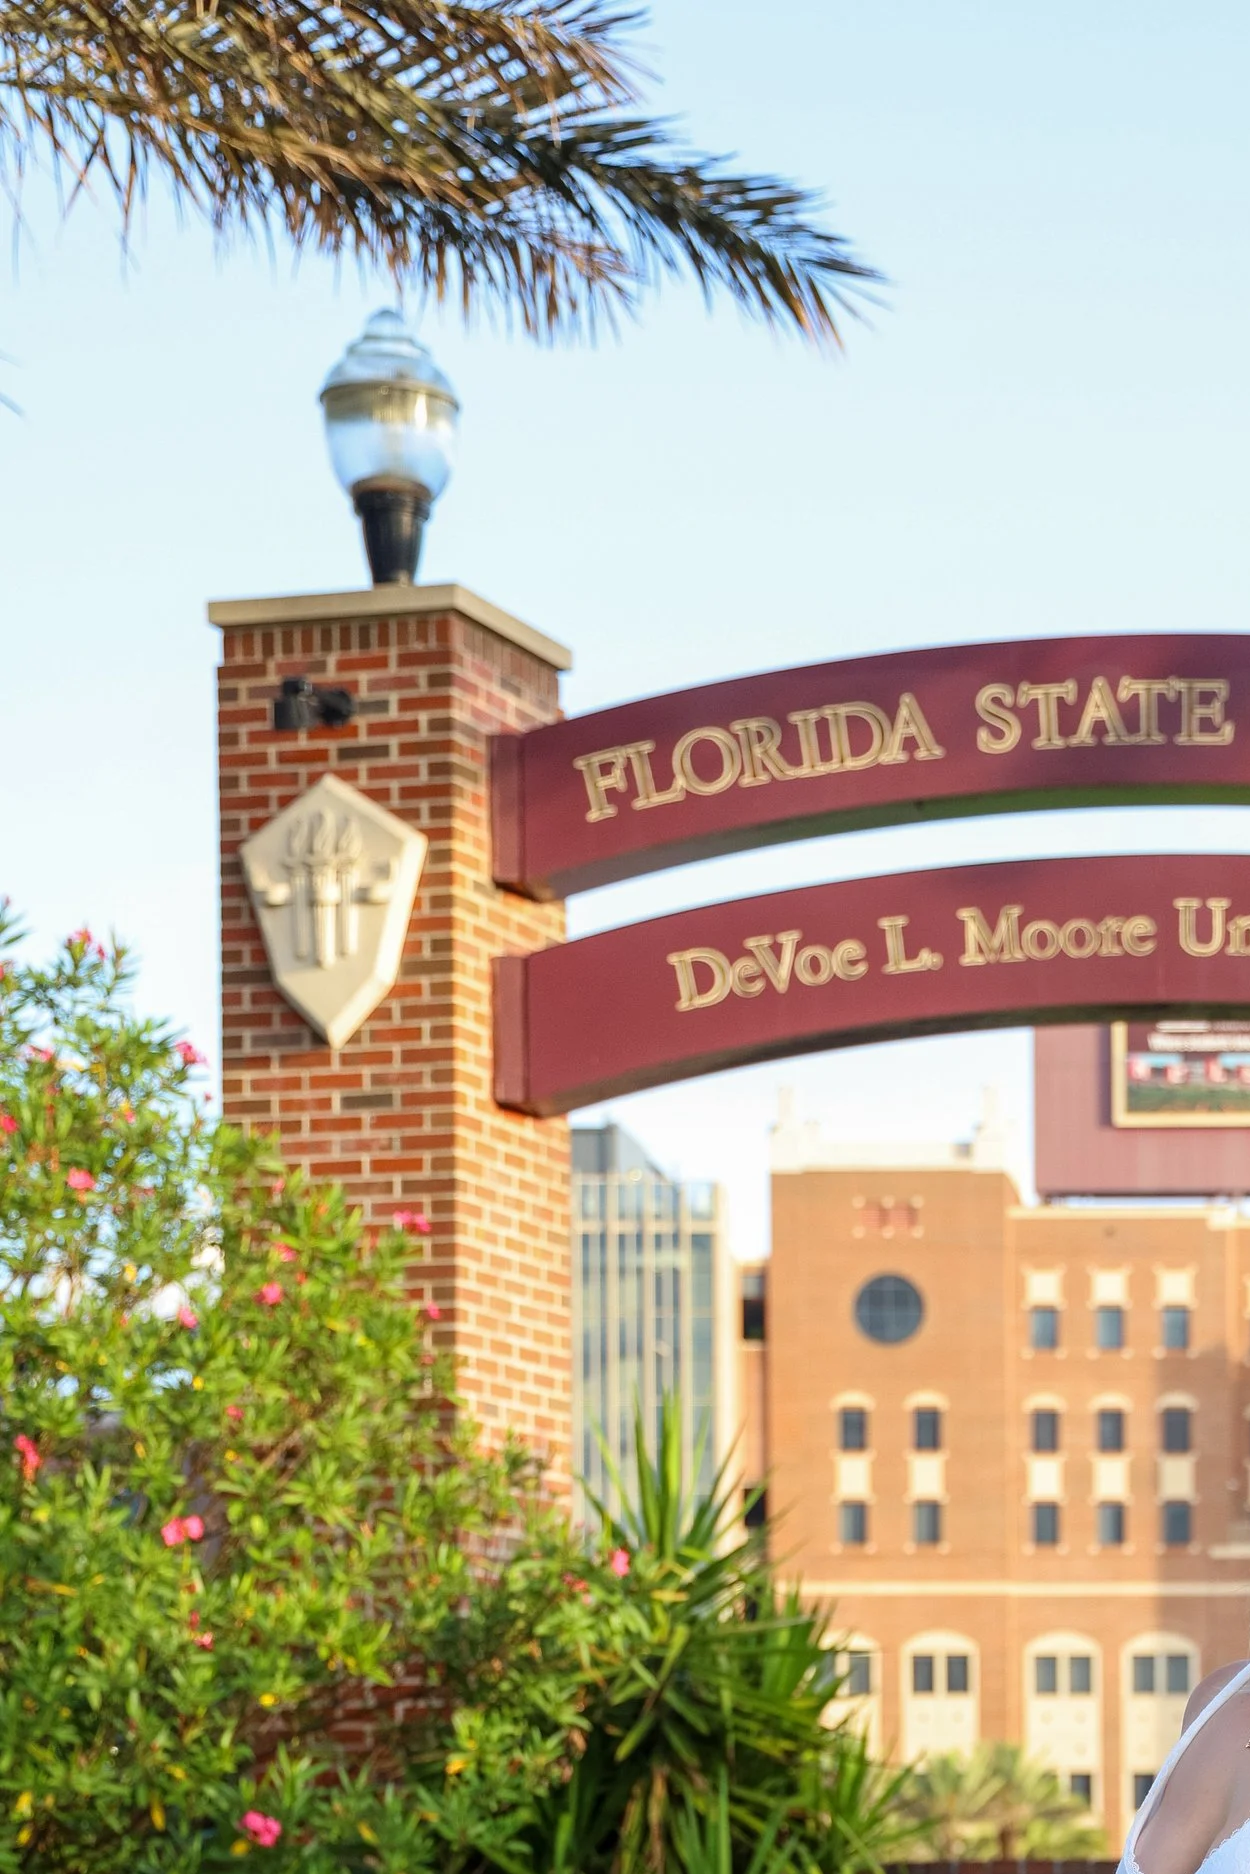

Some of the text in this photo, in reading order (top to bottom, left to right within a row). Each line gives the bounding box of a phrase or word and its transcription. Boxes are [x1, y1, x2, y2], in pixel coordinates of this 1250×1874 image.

[574, 692, 946, 823] FLORIDA
[974, 675, 1235, 755] STATE
[666, 929, 869, 1013] DeVoe
[876, 915, 944, 976] L.
[956, 904, 1158, 967] Moore
